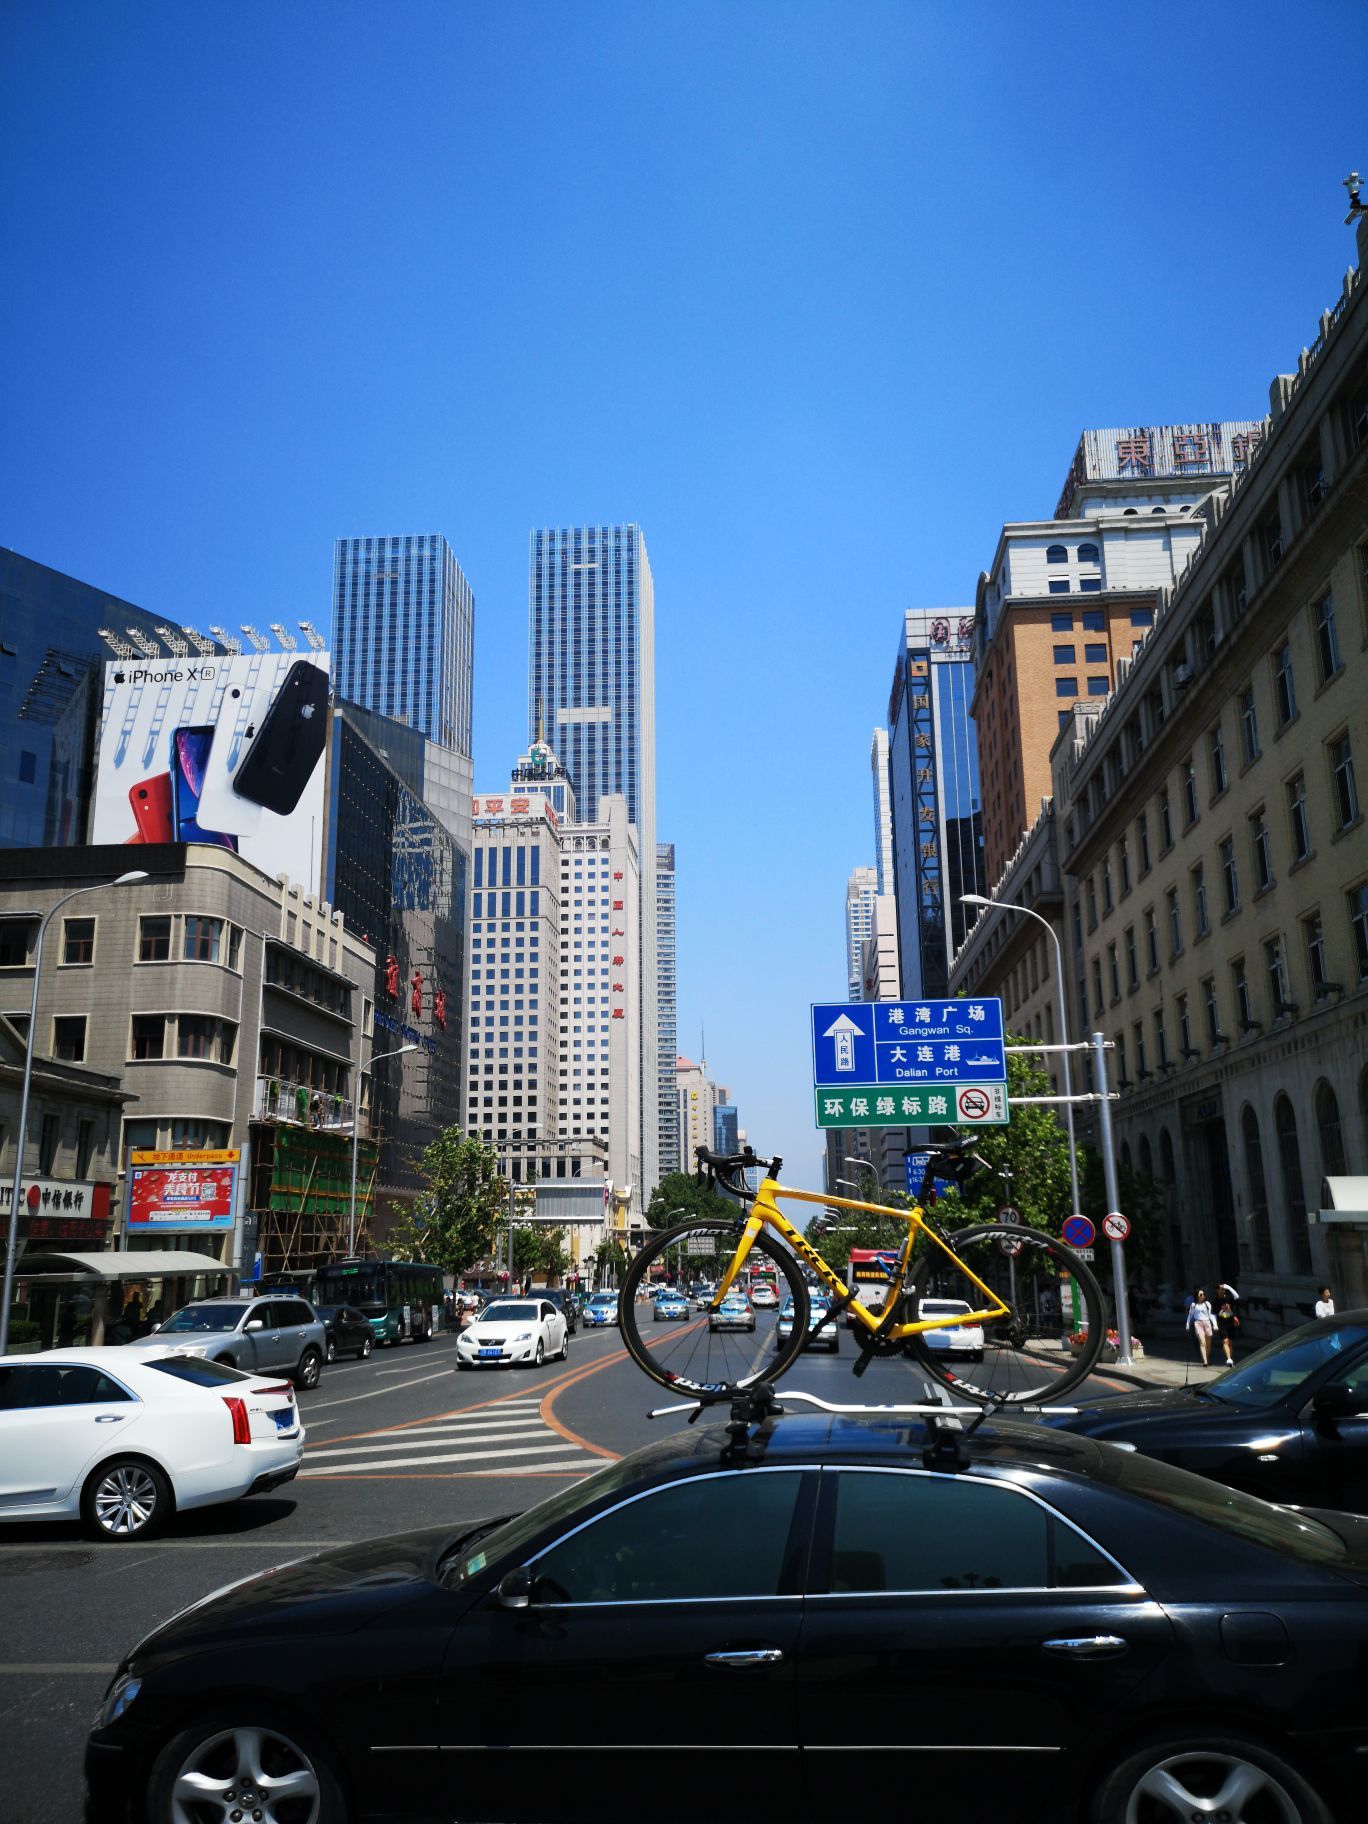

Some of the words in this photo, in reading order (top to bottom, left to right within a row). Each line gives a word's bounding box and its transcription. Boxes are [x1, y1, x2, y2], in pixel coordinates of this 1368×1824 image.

[128, 670, 183, 684] iPhone
[913, 694, 939, 895] 国家开发银行
[888, 1005, 985, 1024] 港湾广场
[899, 1026, 950, 1037] Gangwan
[956, 1025, 974, 1035] Sq.
[840, 1034, 850, 1067] 人民路
[890, 1045, 961, 1062] 大连港
[896, 1068, 928, 1078] Dalian
[936, 1067, 958, 1077] Port
[824, 1095, 948, 1118] 环保绿标路
[153, 1152, 183, 1160] 地下通道
[187, 1152, 222, 1160] Underpass
[164, 1182, 200, 1195] 美食节
[1003, 1211, 1017, 1221] 70
[785, 1222, 842, 1287] TREK
